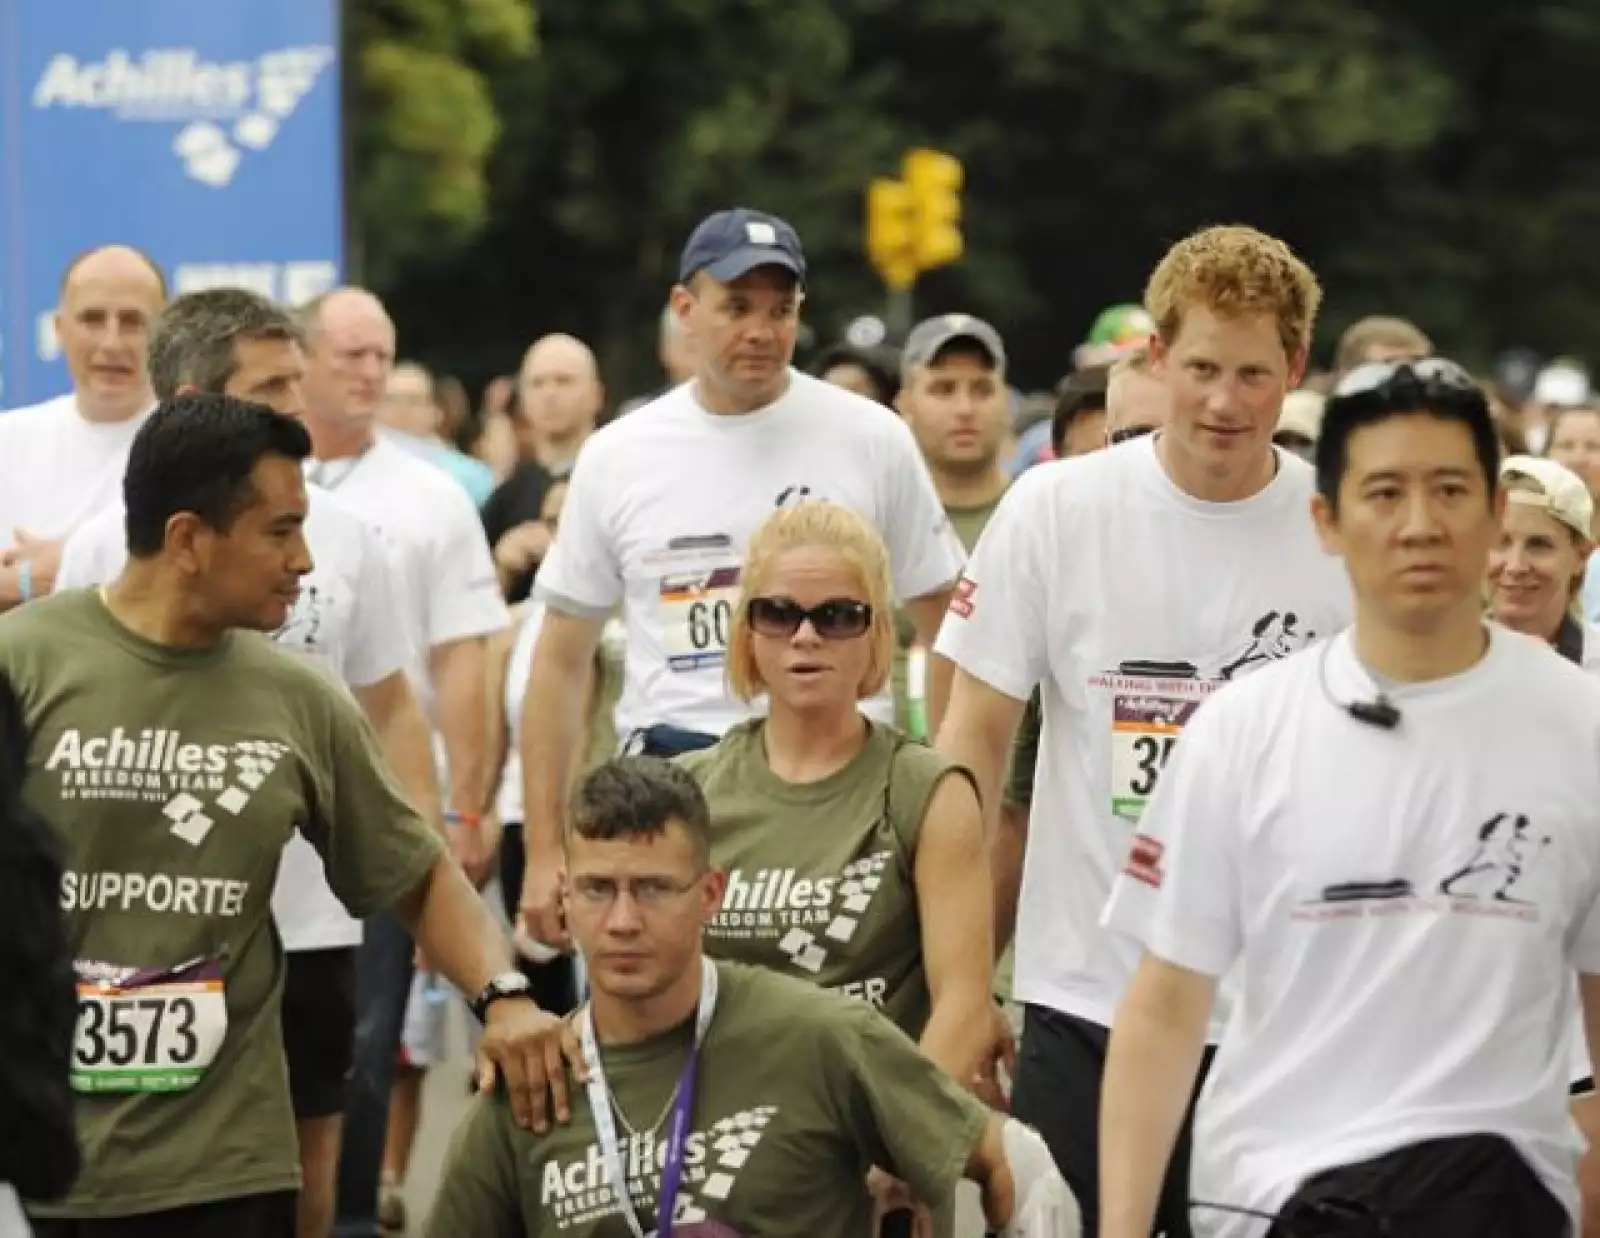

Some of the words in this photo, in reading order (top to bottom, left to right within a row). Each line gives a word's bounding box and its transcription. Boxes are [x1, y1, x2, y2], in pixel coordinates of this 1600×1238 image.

[33, 47, 249, 107] Achilles
[45, 726, 228, 773] Achilles
[61, 769, 161, 788] FREEDOM
[169, 773, 224, 790] TEAM
[721, 867, 837, 910] hilles
[76, 997, 198, 1066] 3573
